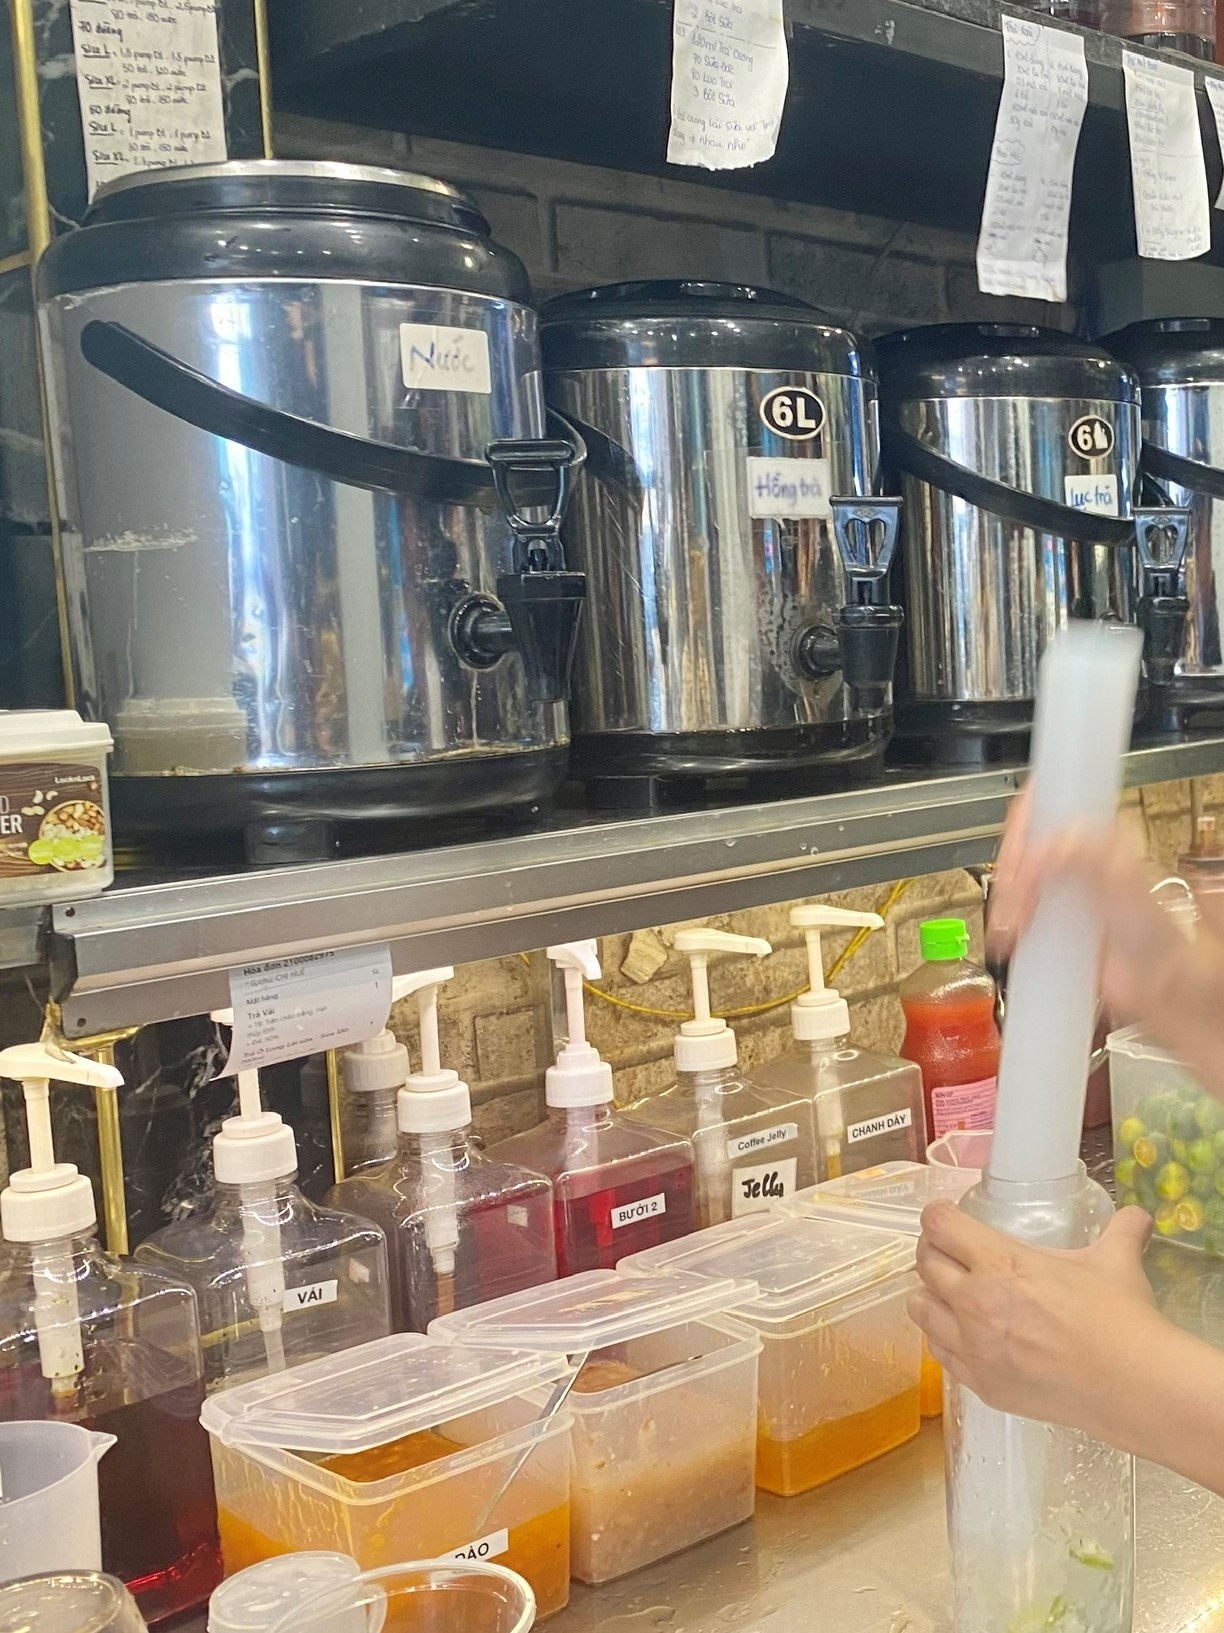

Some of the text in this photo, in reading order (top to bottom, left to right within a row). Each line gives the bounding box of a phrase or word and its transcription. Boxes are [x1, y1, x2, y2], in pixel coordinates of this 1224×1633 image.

[772, 395, 816, 429] 6L
[852, 1114, 906, 1138] CHANH DÂY
[738, 1129, 787, 1151] Coffee Jelly
[741, 1171, 783, 1198] Jelly
[619, 1201, 658, 1222] BƯỞI 2
